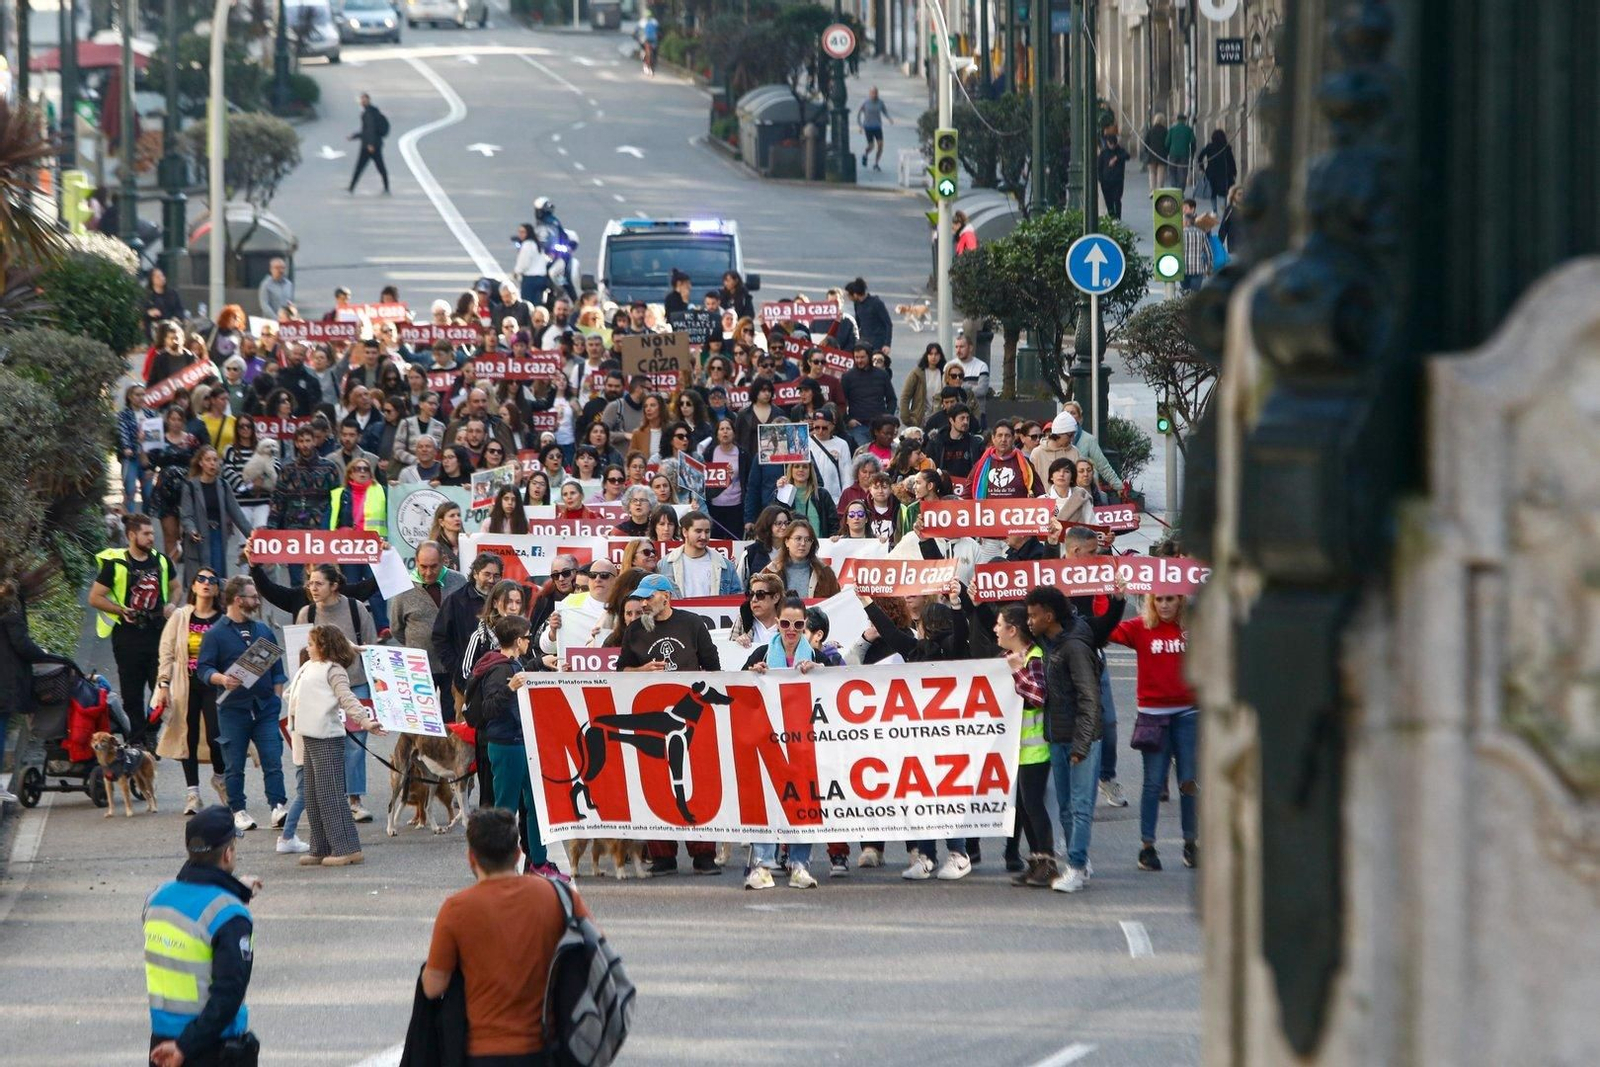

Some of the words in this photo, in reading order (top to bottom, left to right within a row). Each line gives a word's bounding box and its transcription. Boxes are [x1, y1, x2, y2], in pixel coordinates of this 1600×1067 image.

[830, 35, 848, 46] 40
[763, 306, 780, 315] no
[783, 306, 791, 315] a
[793, 303, 805, 315] la
[808, 304, 837, 315] caza
[280, 325, 297, 337] no
[299, 326, 308, 336] a
[309, 321, 323, 336] la
[325, 324, 355, 336] caza
[402, 328, 419, 339] no
[421, 329, 430, 339] a
[432, 326, 445, 339] la
[447, 328, 477, 339] caza
[641, 334, 676, 348] NON
[784, 340, 800, 353] no
[825, 352, 855, 369] caza
[476, 362, 494, 373] no
[496, 362, 506, 373] a
[508, 358, 523, 373] la
[524, 362, 556, 374] caza
[637, 357, 679, 373] CAZA
[143, 392, 161, 405] no
[731, 391, 749, 402] no
[779, 385, 801, 398] caz
[270, 422, 279, 433] a
[282, 419, 296, 433] la
[533, 414, 555, 426] aza
[522, 460, 541, 471] za
[923, 510, 952, 528] no
[956, 509, 970, 527] a
[975, 502, 995, 526] la
[1000, 507, 1050, 526] caza
[1095, 509, 1133, 524] caza
[533, 524, 556, 536] no
[561, 524, 572, 536] a
[575, 520, 593, 536] la
[253, 538, 282, 554] no
[286, 538, 300, 554] a
[305, 533, 325, 554] la
[330, 538, 378, 555] caza
[858, 567, 881, 585] no
[885, 567, 897, 585] a
[900, 561, 917, 585] la
[920, 565, 955, 585] caza
[977, 571, 1009, 590] no
[1013, 569, 1028, 587] a
[1033, 561, 1056, 586] la
[1061, 564, 1115, 585] caza
[1119, 564, 1134, 582] o
[1138, 564, 1153, 582] a
[1160, 559, 1181, 583] la
[1187, 566, 1212, 584] ca
[870, 585, 894, 595] perros
[979, 590, 996, 599] con
[997, 587, 1028, 599] perros
[1127, 583, 1152, 591] erros
[571, 655, 602, 670] no
[809, 698, 829, 724] Á
[836, 675, 1004, 725] CAZA
[769, 731, 802, 744] CON
[807, 728, 869, 742] GALGOS
[874, 728, 884, 740] E
[889, 725, 951, 739] OUTRAS
[956, 723, 1006, 736] RAZAS
[528, 682, 823, 826] NON
[782, 781, 801, 802] A
[809, 780, 846, 801] LA
[849, 752, 1011, 802] CAZA
[796, 808, 829, 821] CON
[834, 805, 896, 818] GALGOS
[901, 805, 910, 817] Y
[914, 803, 966, 816] OTRAS
